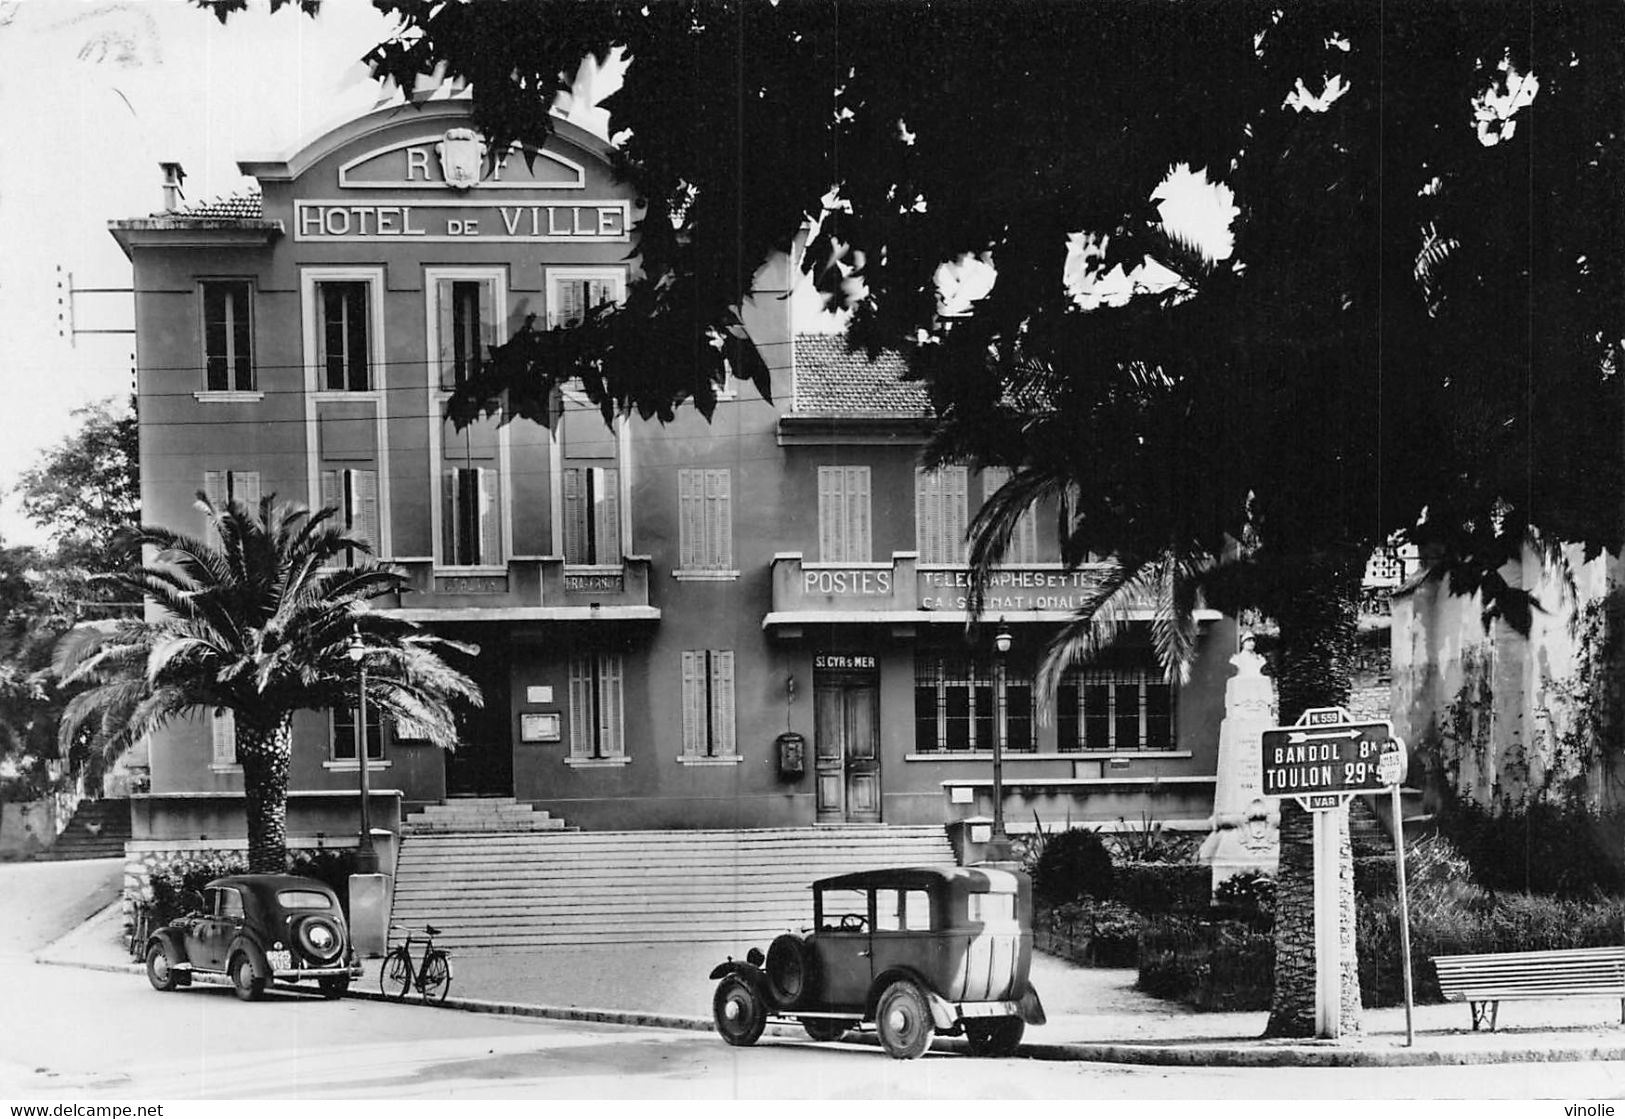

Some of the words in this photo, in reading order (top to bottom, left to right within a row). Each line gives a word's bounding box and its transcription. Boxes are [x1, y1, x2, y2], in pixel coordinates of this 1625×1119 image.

[405, 147, 431, 181] R
[301, 207, 426, 235] HOTEL
[447, 219, 479, 235] DE
[500, 207, 623, 235] VILLE
[805, 571, 890, 594] POSTES
[854, 655, 875, 668] MER
[1275, 744, 1340, 764] BANDOL
[1267, 765, 1332, 789] TOULON
[1314, 796, 1335, 807] VAR
